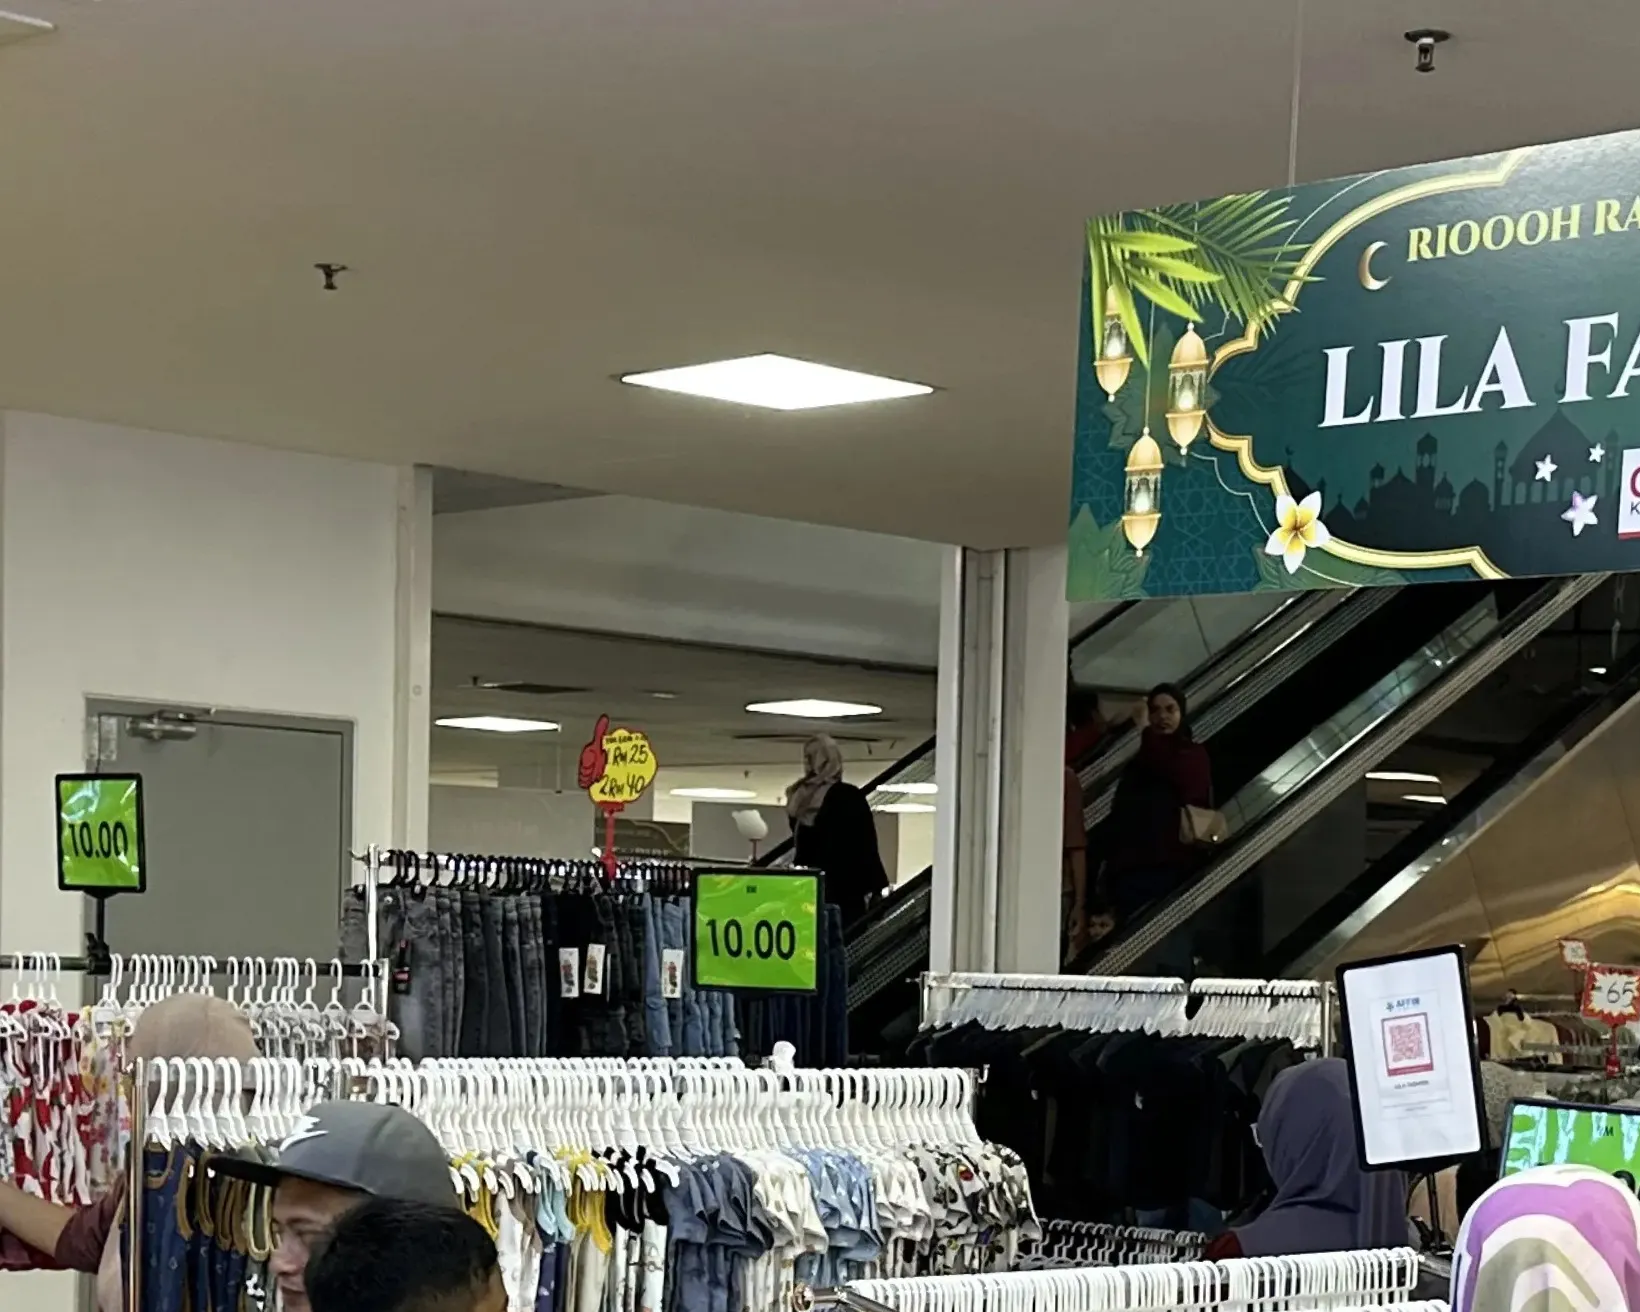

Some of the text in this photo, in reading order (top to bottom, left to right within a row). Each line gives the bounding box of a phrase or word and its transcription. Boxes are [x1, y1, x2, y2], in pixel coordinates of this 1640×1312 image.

[1407, 203, 1582, 262] RIOOOH
[1318, 325, 1537, 428] LILA
[68, 821, 129, 858] 10.00
[706, 918, 796, 960] 10.00
